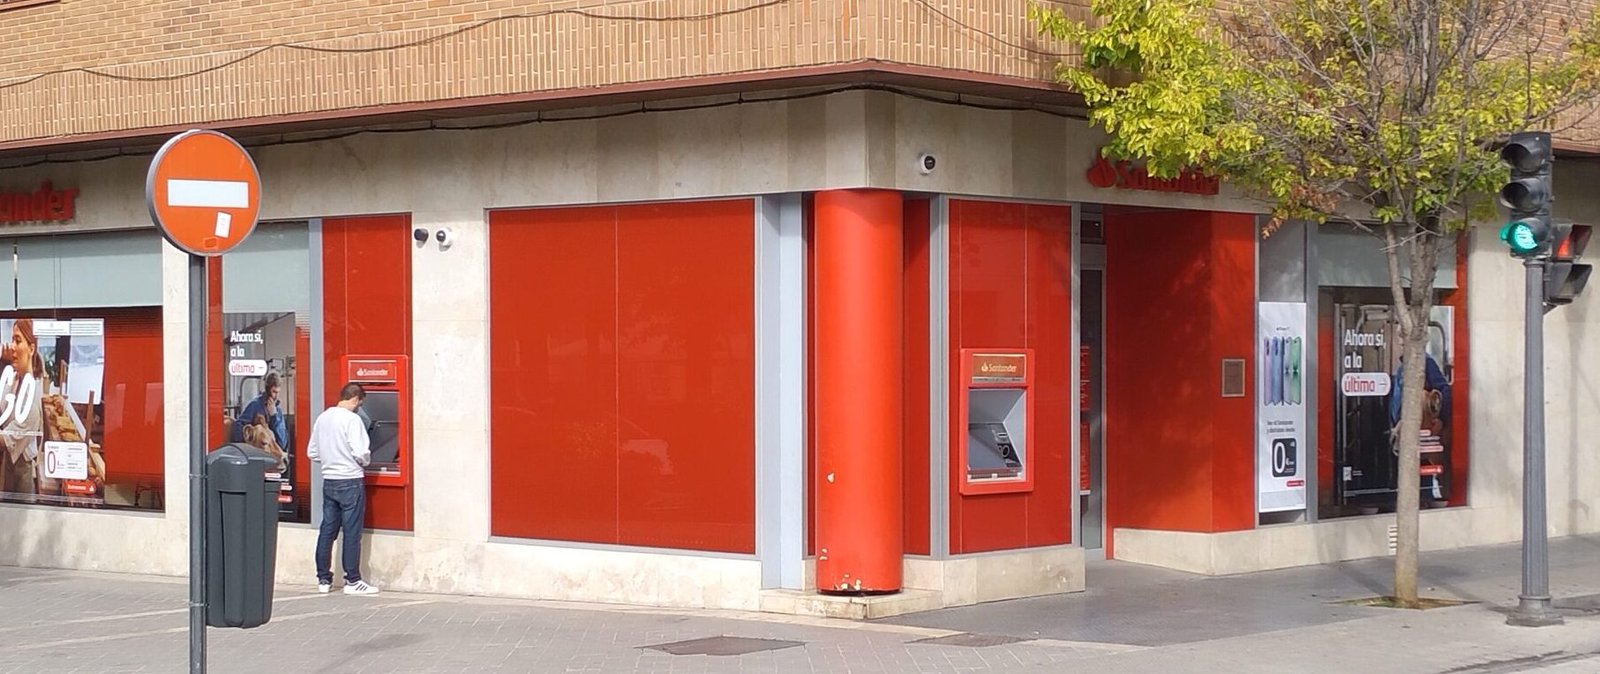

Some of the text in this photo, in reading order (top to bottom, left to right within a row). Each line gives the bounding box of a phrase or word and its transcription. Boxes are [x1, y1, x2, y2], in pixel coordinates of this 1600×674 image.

[231, 331, 253, 342] Ahora
[1344, 329, 1374, 346] Ahora
[231, 345, 245, 357] a la
[1345, 352, 1362, 368] a la
[988, 363, 1017, 372] Santander
